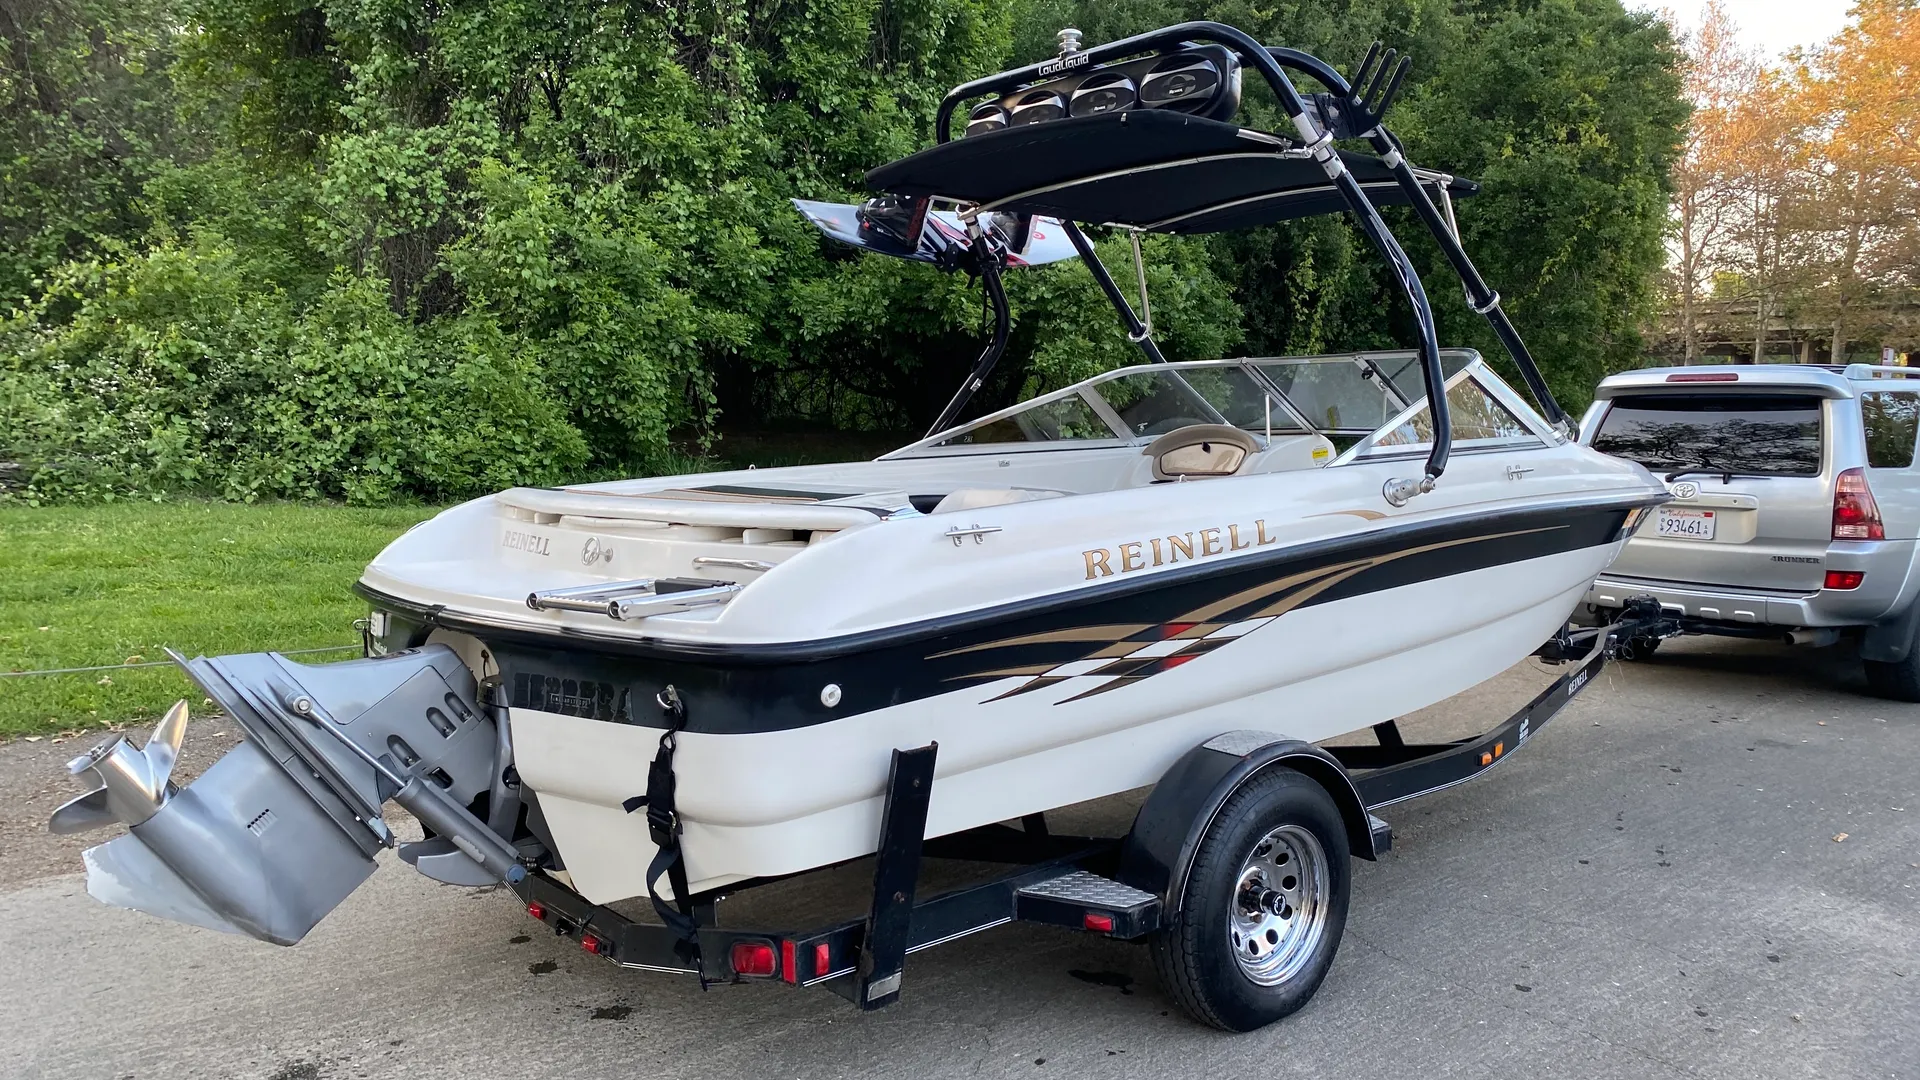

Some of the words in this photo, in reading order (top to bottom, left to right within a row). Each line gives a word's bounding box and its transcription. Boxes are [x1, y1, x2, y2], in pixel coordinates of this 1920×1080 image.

[1668, 509, 1702, 519] California
[1665, 518, 1701, 534] 93461
[502, 530, 551, 557] REINELL
[1083, 519, 1277, 580] REINELL
[1770, 555, 1820, 564] 4RUNNER
[1568, 669, 1588, 695] REINELL
